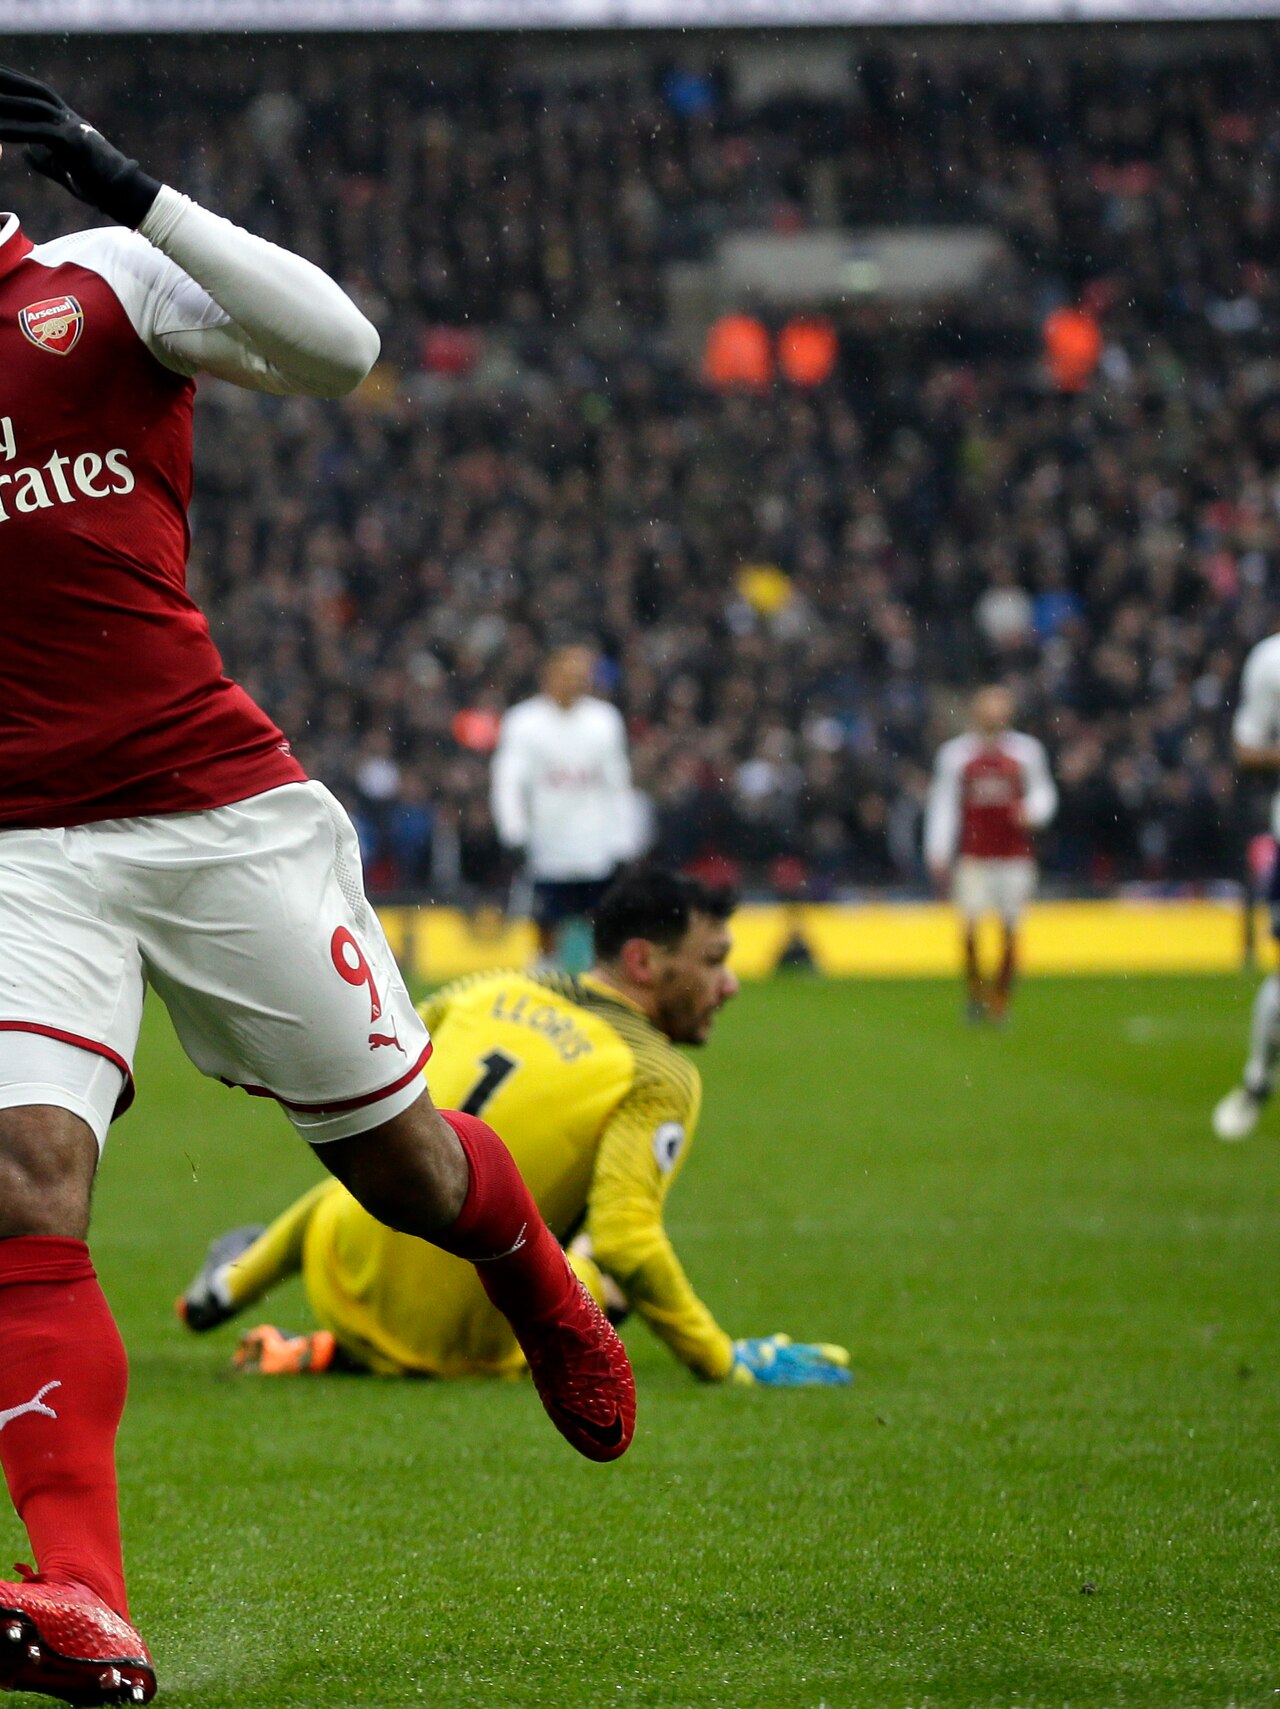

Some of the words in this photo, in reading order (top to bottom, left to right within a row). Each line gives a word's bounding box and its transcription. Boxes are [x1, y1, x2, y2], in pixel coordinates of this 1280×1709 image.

[27, 301, 72, 323] Arsenal
[330, 925, 382, 1024] 9
[460, 1051, 518, 1116] 1
